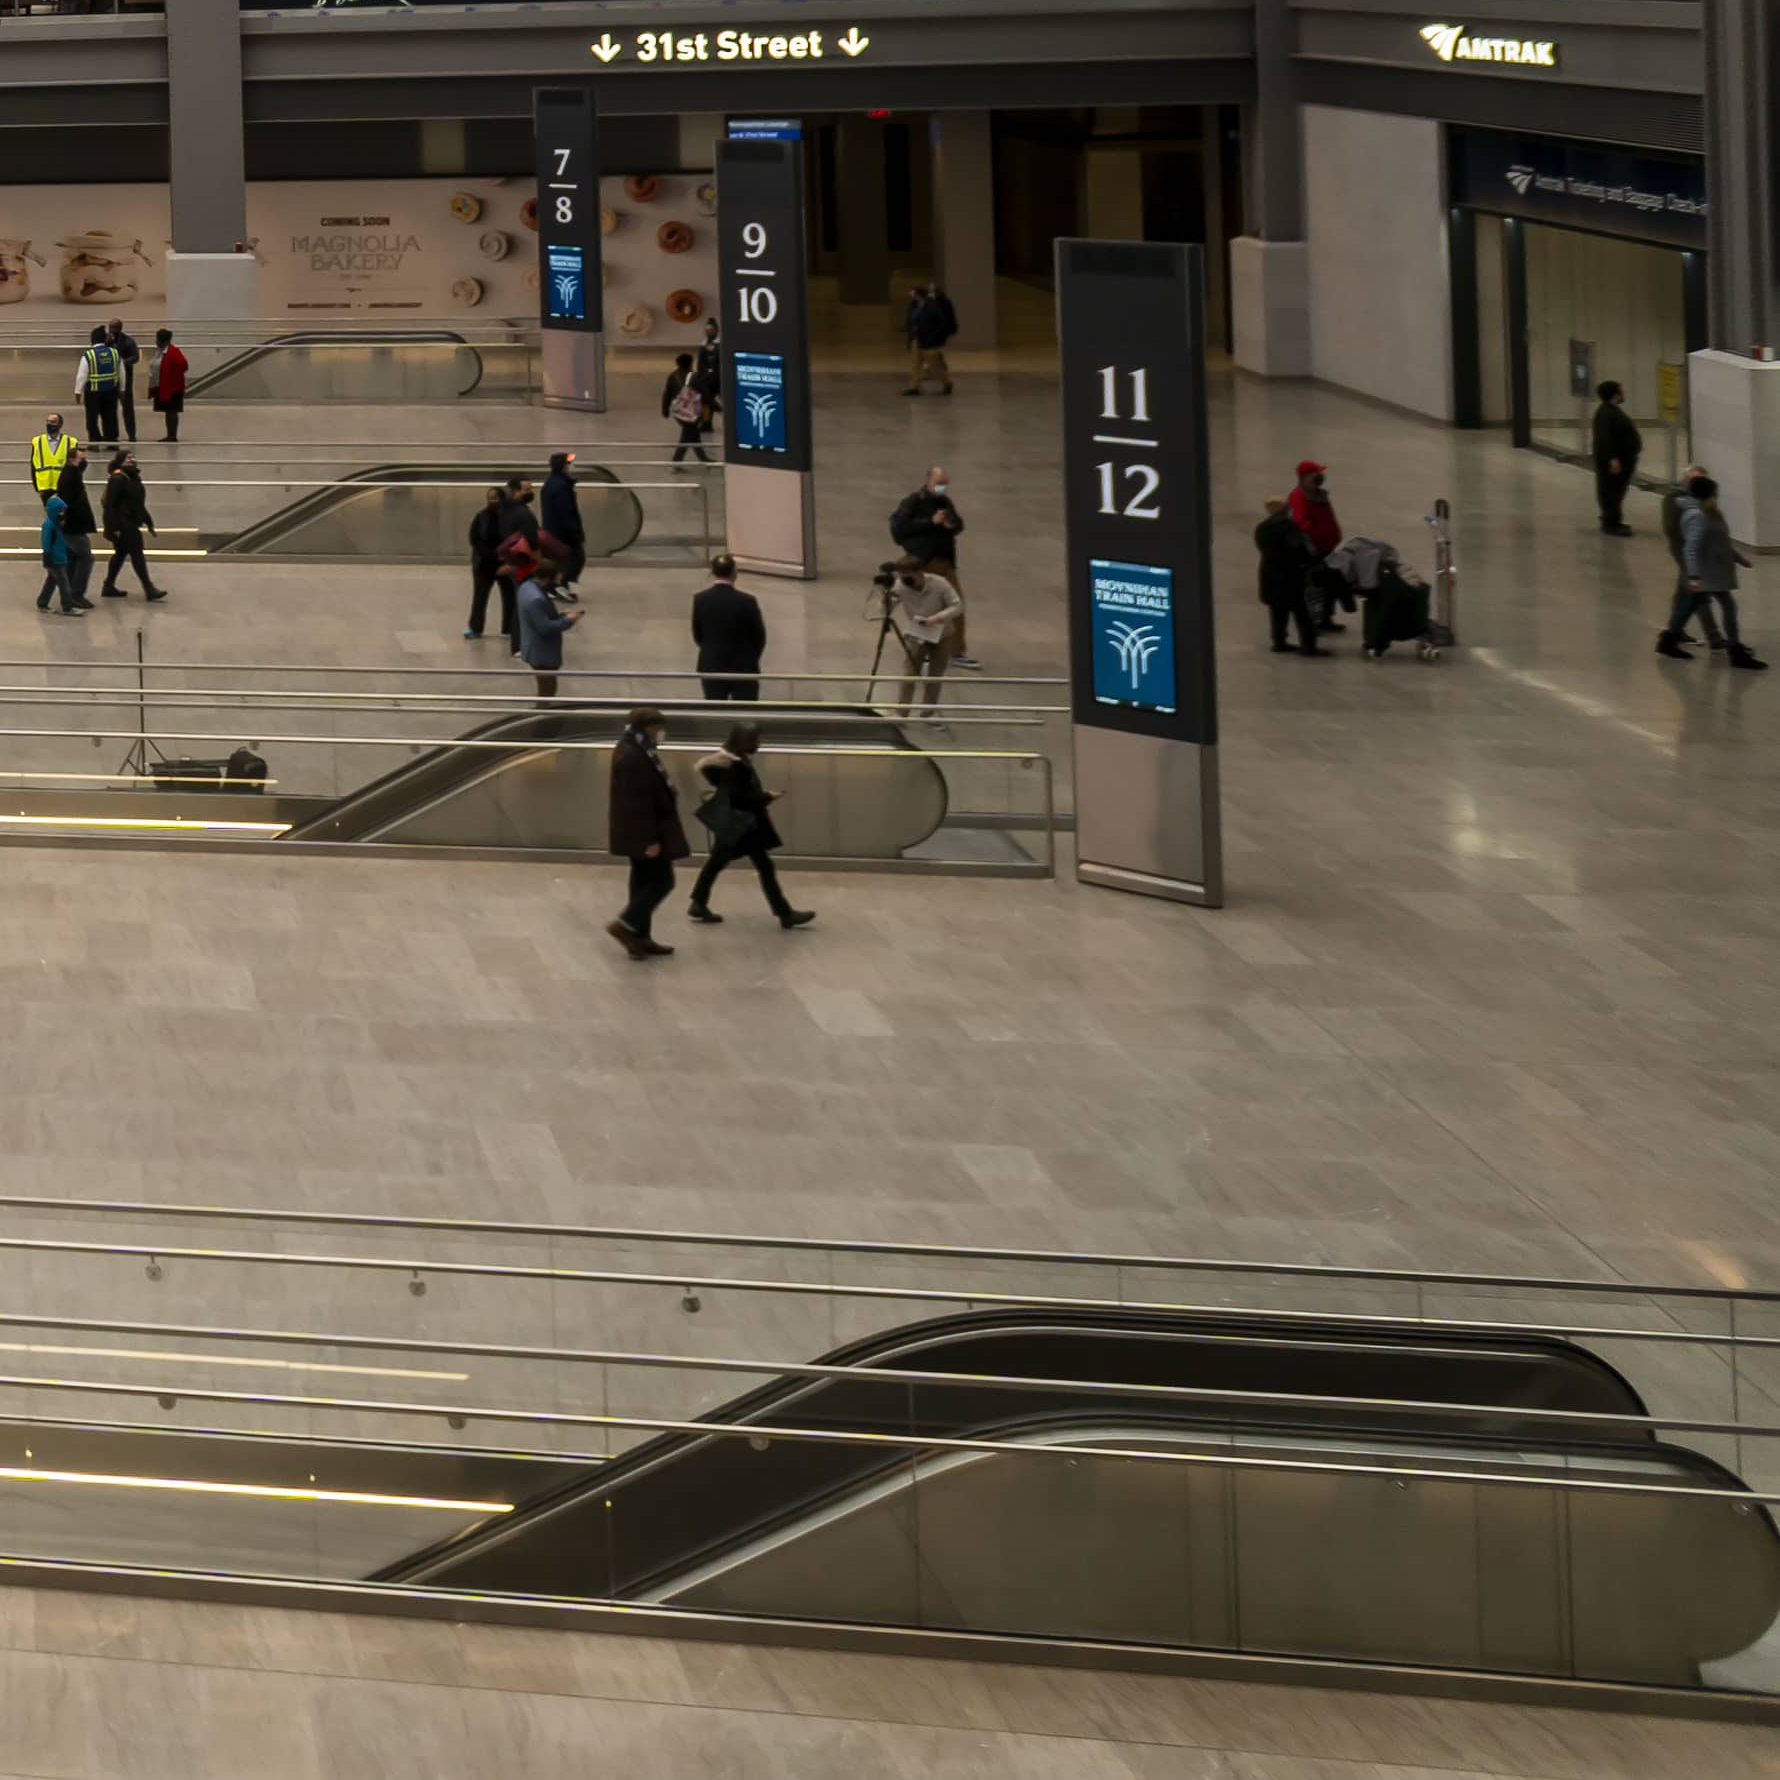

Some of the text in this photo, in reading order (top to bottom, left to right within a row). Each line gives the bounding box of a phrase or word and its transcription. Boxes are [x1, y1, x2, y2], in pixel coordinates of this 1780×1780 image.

[637, 29, 823, 61] 31st Street
[1454, 37, 1555, 66] AMTRAK
[553, 149, 570, 177] 7
[556, 196, 573, 224] 8
[291, 235, 422, 252] MAGNOLIA
[742, 222, 767, 259] 9
[310, 253, 403, 271] BAKERY
[739, 286, 778, 324] 10
[1097, 364, 1150, 422] 11
[1095, 461, 1160, 520] 12
[1094, 590, 1171, 609] TRAIN HALL
